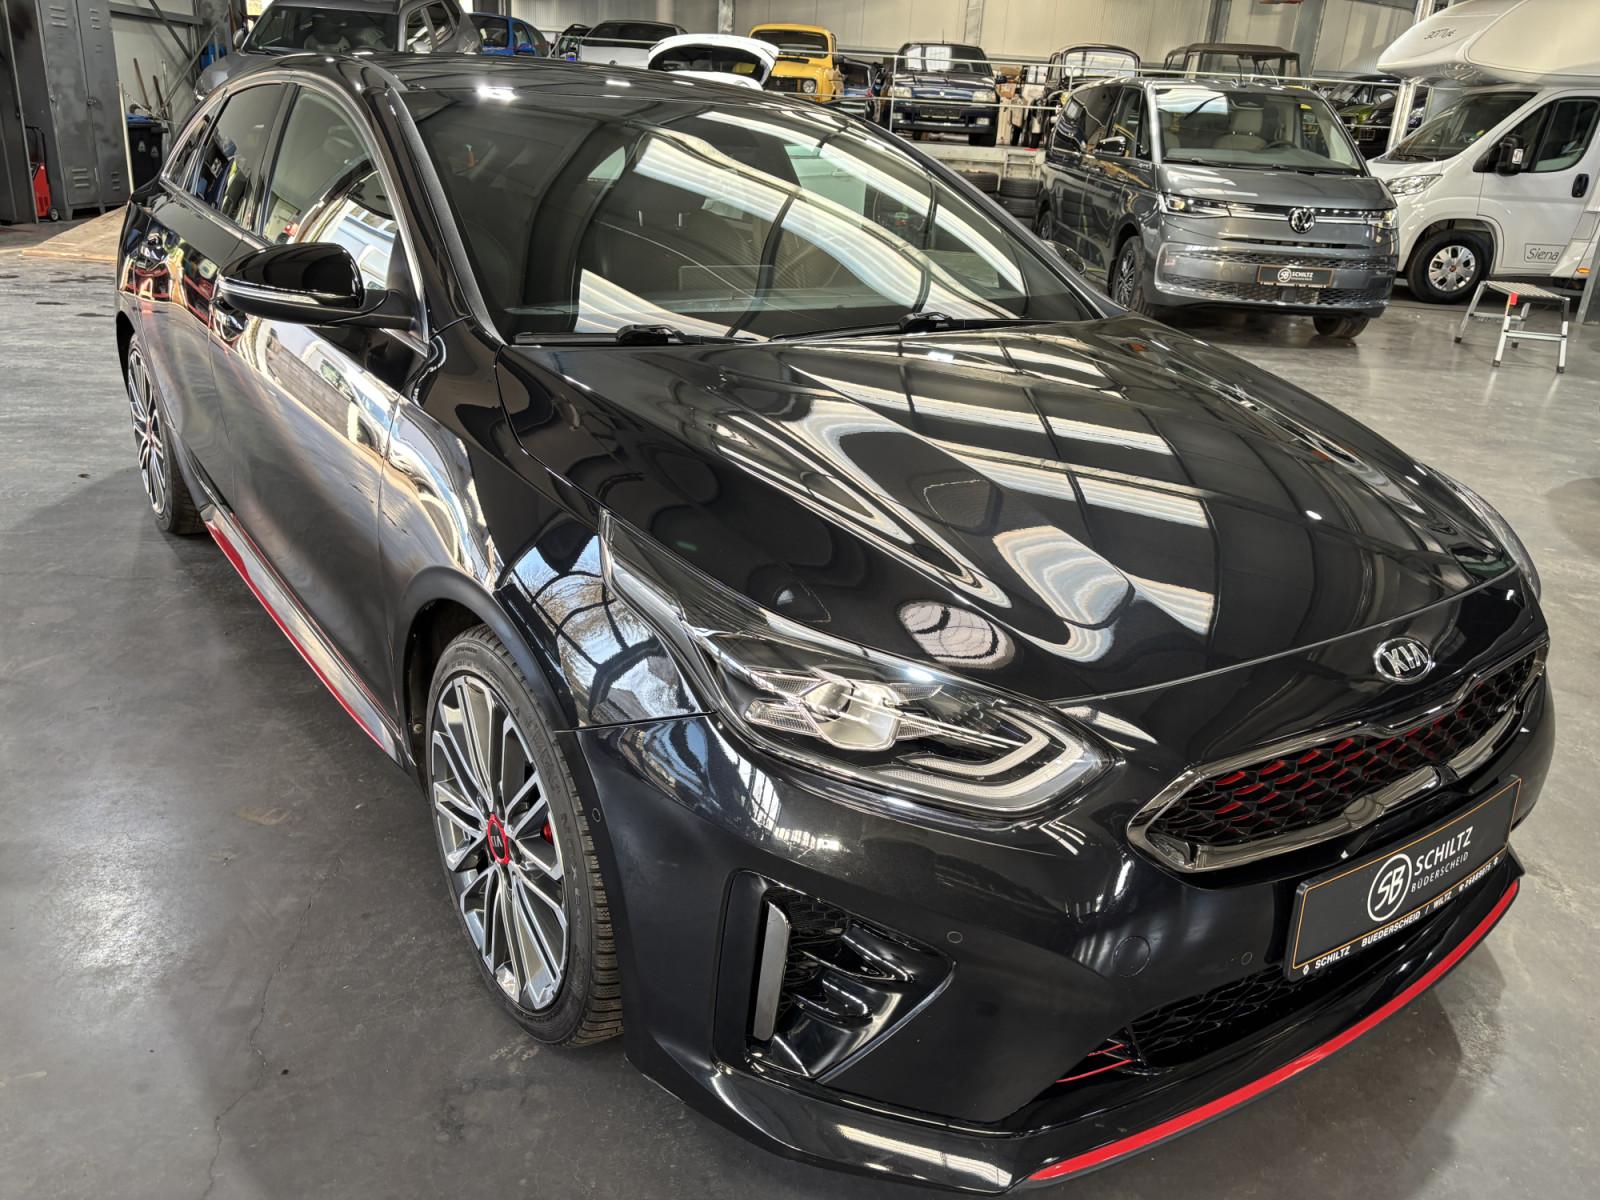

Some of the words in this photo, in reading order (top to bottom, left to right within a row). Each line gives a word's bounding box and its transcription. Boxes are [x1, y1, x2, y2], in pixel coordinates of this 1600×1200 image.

[1526, 247, 1560, 261] Siena
[1382, 642, 1428, 676] KIA
[1414, 826, 1474, 876] SCHILTZ
[1314, 945, 1351, 969] SCHILTZ
[1361, 910, 1421, 947] BUEDERSCHEID
